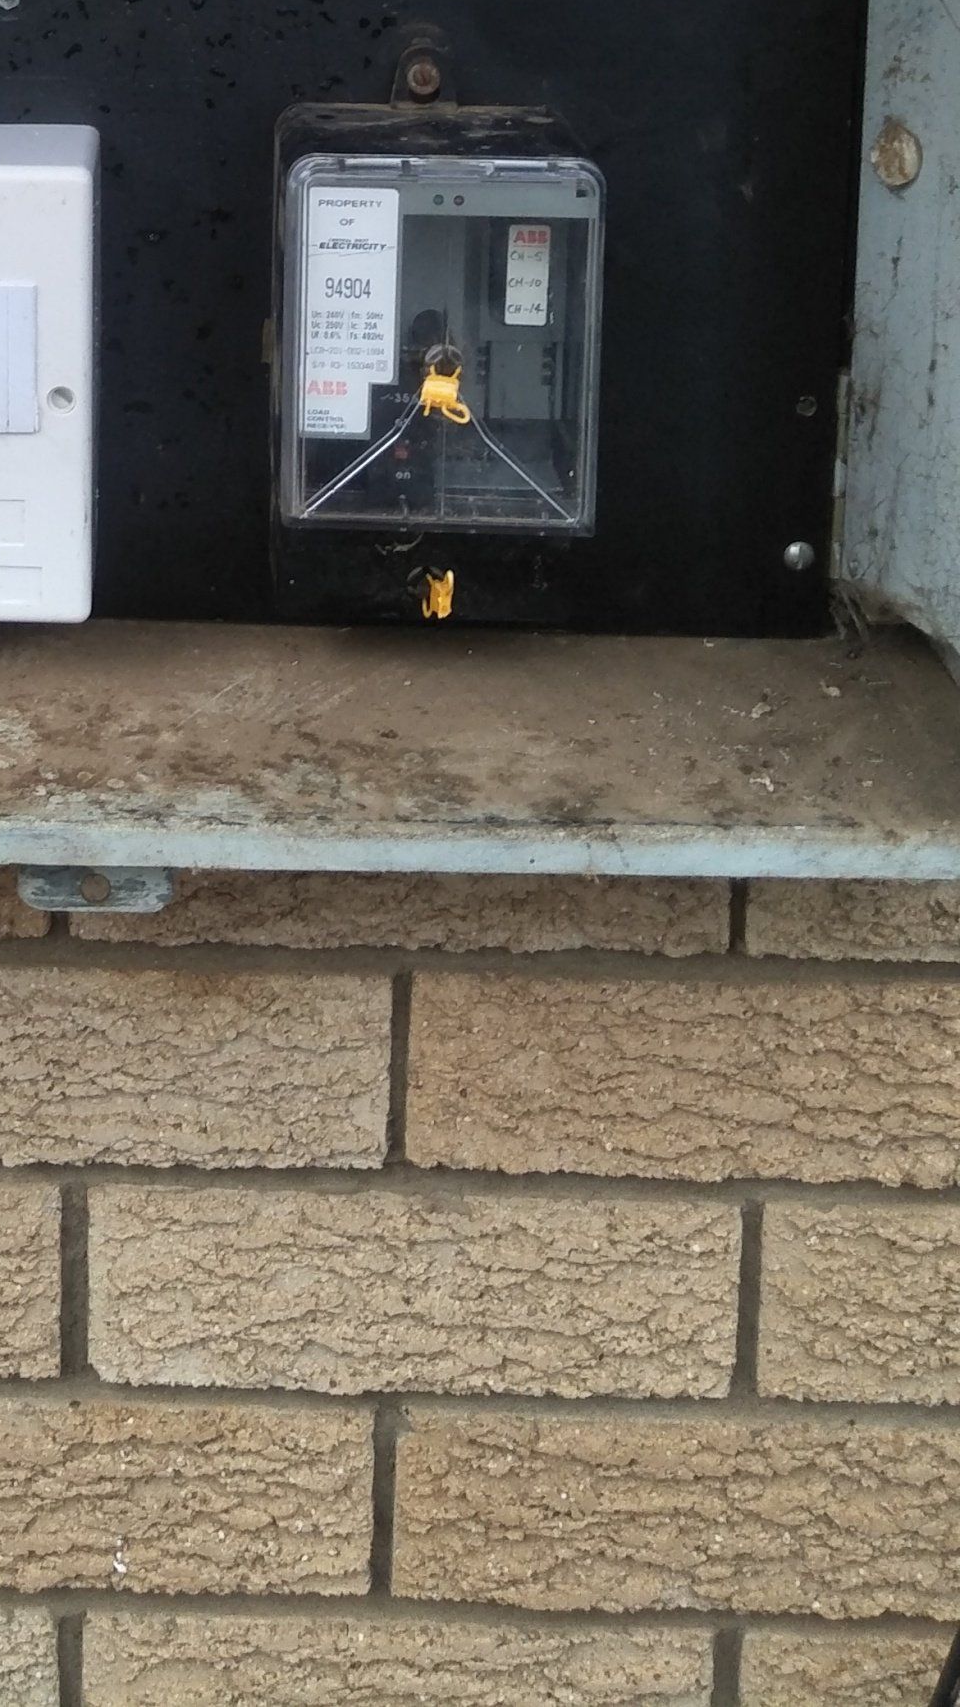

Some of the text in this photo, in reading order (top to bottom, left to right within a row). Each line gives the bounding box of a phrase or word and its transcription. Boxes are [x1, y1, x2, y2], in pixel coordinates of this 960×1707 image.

[318, 198, 383, 208] PROPERTY
[339, 218, 356, 226] OF
[513, 230, 548, 244] ABB
[318, 242, 388, 251] ELECTRICITY
[324, 277, 372, 300] 94904
[307, 380, 348, 395] ABB
[395, 471, 411, 480] on
